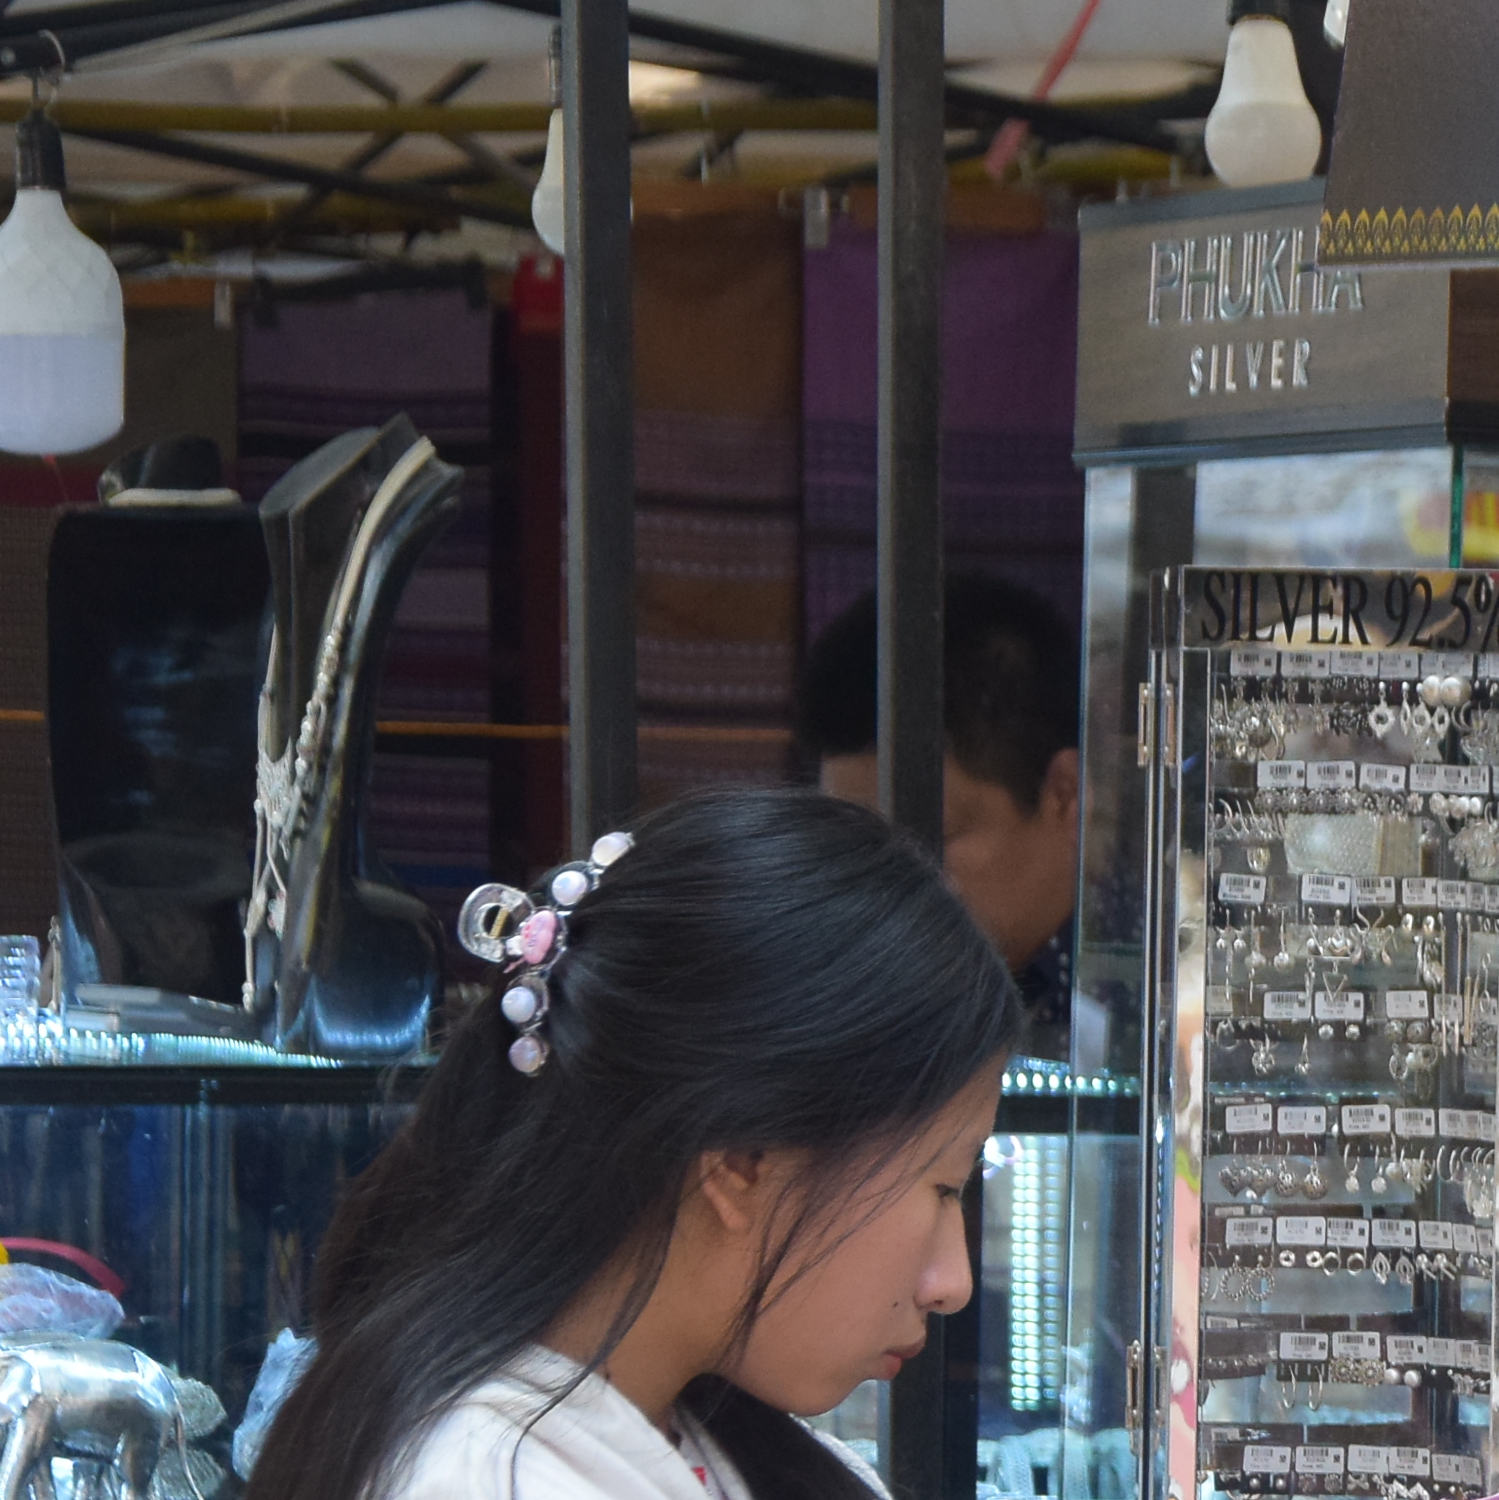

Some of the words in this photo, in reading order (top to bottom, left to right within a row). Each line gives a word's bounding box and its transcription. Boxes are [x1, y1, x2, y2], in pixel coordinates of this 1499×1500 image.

[1148, 224, 1364, 328] PHUKHA
[1188, 337, 1311, 398] SILVER
[1201, 570, 1371, 647] SILVER
